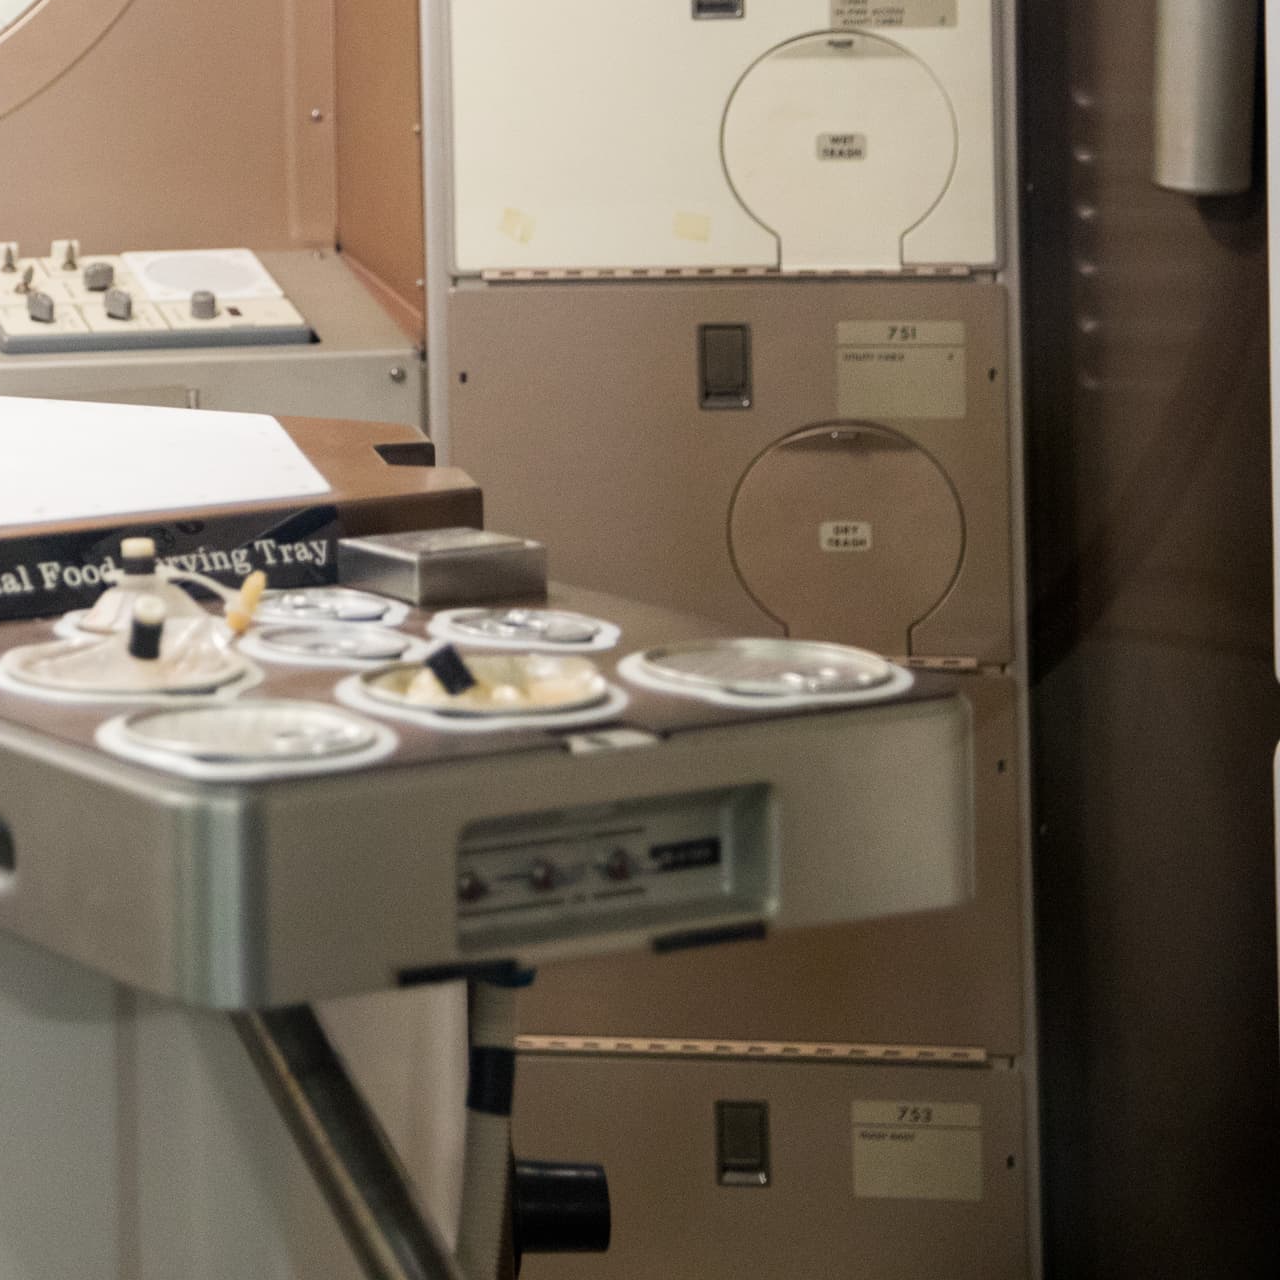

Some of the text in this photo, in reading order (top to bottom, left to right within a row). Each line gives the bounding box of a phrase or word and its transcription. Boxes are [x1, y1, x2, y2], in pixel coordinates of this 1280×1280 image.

[37, 556, 118, 590] Food
[155, 546, 252, 575] rving
[253, 537, 330, 567] Tray
